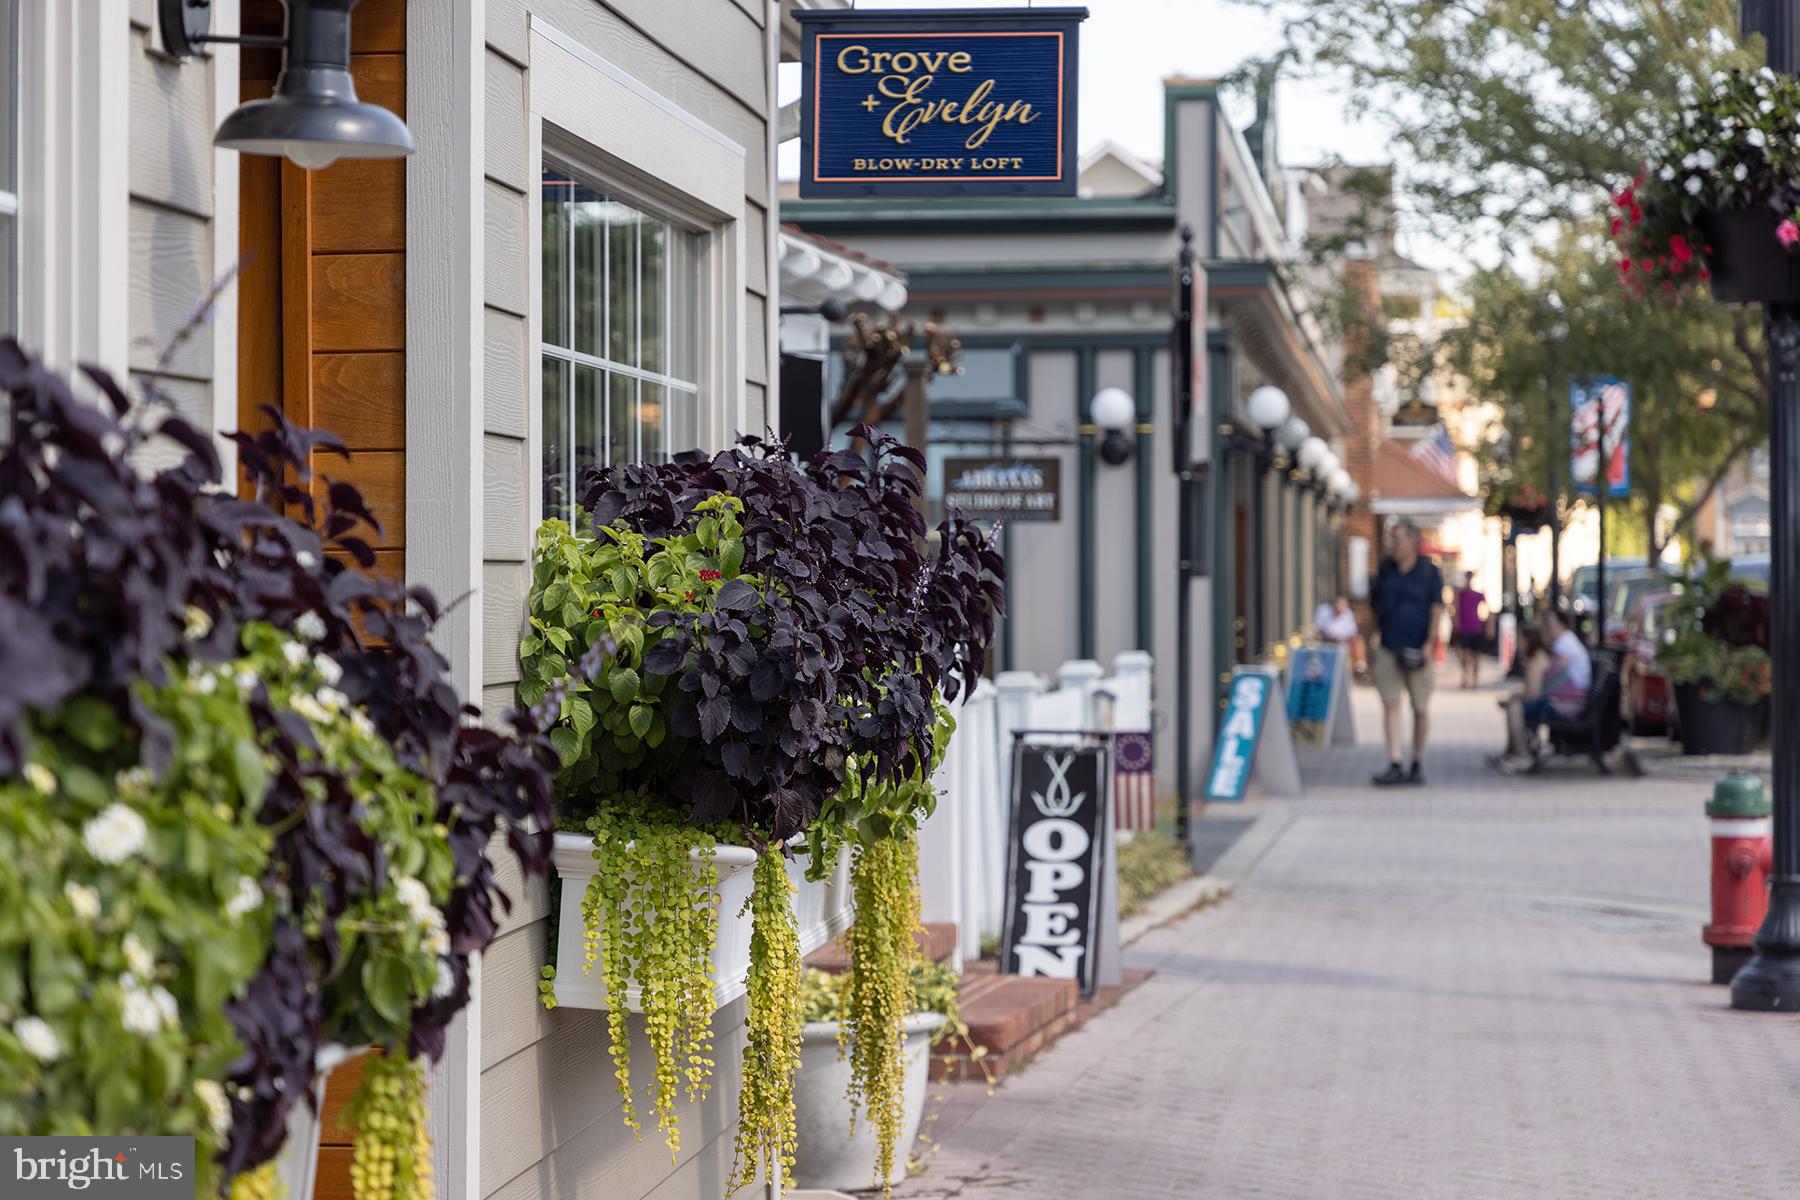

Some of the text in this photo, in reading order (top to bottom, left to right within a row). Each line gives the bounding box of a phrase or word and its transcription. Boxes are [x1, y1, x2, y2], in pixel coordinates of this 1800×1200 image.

[837, 45, 972, 74] Grove
[861, 75, 1041, 149] + Evelyn
[853, 158, 1022, 171] BLOW-DRY LOFT
[1210, 677, 1264, 797] SALE
[1013, 818, 1089, 978] OPEN
